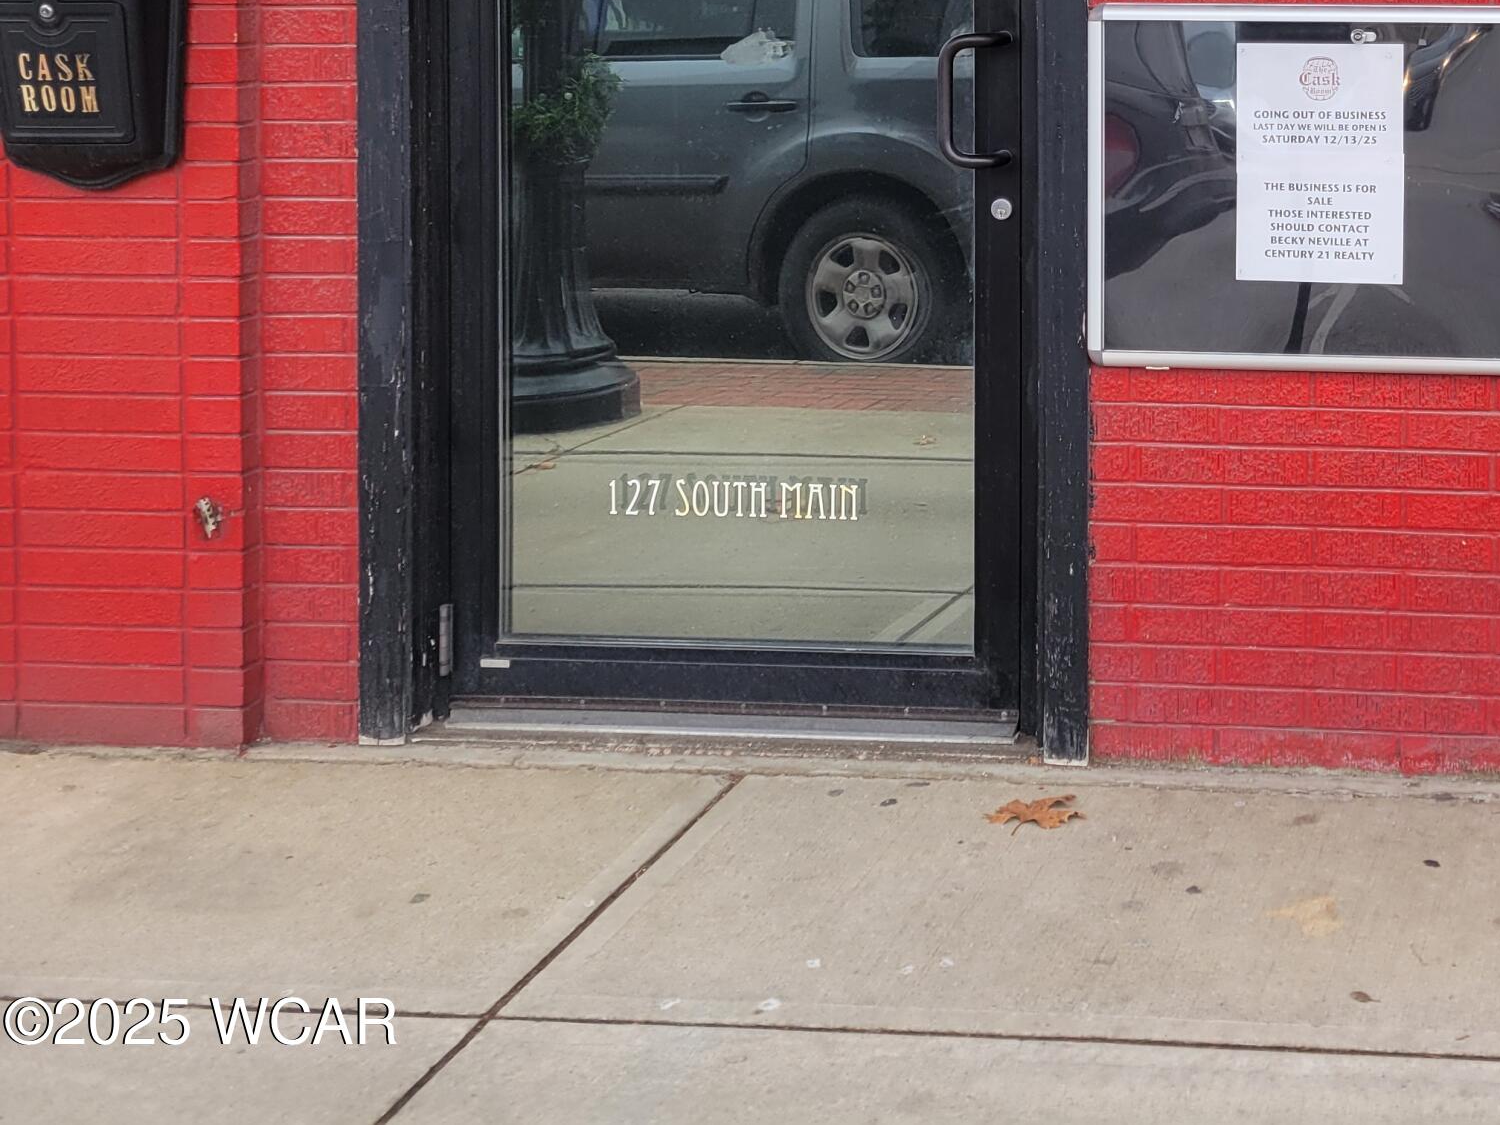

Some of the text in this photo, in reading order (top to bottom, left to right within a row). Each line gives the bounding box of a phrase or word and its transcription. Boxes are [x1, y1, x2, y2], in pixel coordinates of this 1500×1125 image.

[17, 52, 95, 81] CASK
[1299, 71, 1341, 86] Cask
[19, 84, 100, 114] ROOM
[1254, 110, 1387, 120] GOING OUT OF BUSINESS
[1253, 123, 1274, 131] LAST
[1277, 123, 1295, 131] DAY
[1297, 123, 1312, 131] WE
[1314, 123, 1336, 131] WILL
[1351, 124, 1376, 132] OPEN
[1378, 124, 1387, 132] IS
[1262, 134, 1377, 145] SATURDAY 12/13/25
[1264, 182, 1377, 194] THE BUSINESS IS FOR
[1307, 196, 1333, 206] SALE
[1268, 209, 1372, 220] THOSE INTERESTED
[1270, 222, 1370, 233] SHOULD CONTACT
[1270, 236, 1369, 247] BECKY NEVILLE AT
[1264, 249, 1375, 261] CENTURY 21 REALTY
[609, 478, 859, 520] 127 SOUTH MAIN
